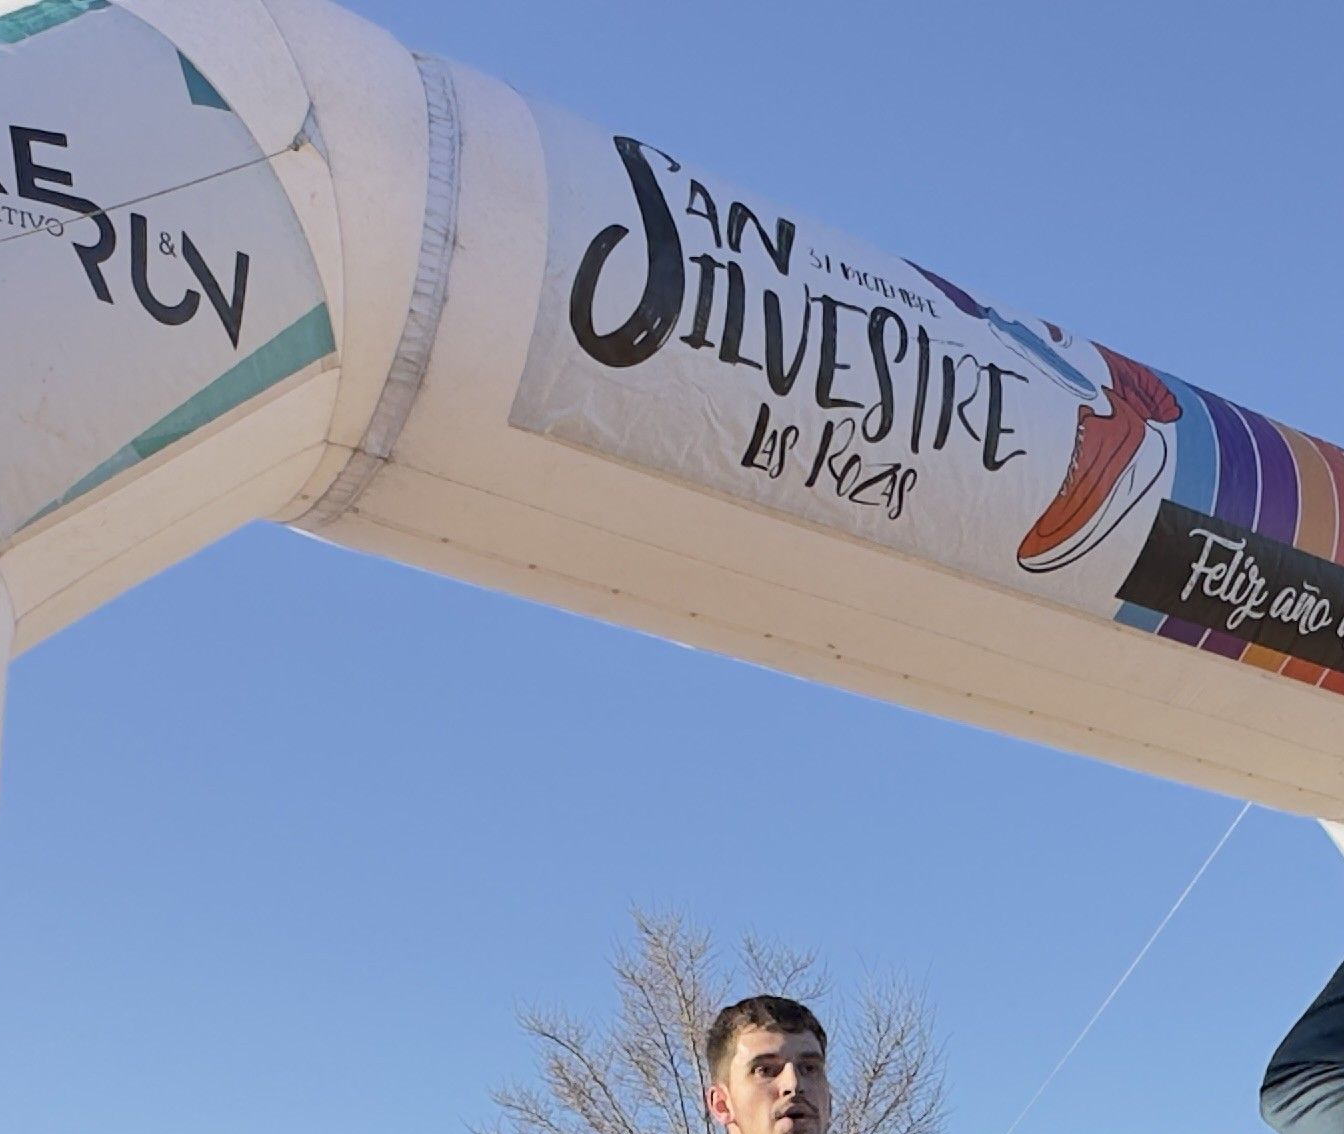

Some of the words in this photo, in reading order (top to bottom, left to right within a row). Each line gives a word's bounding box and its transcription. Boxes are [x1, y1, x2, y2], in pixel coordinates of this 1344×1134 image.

[158, 231, 178, 258] &
[1180, 527, 1270, 631] Feliz
[1268, 580, 1332, 636] año
